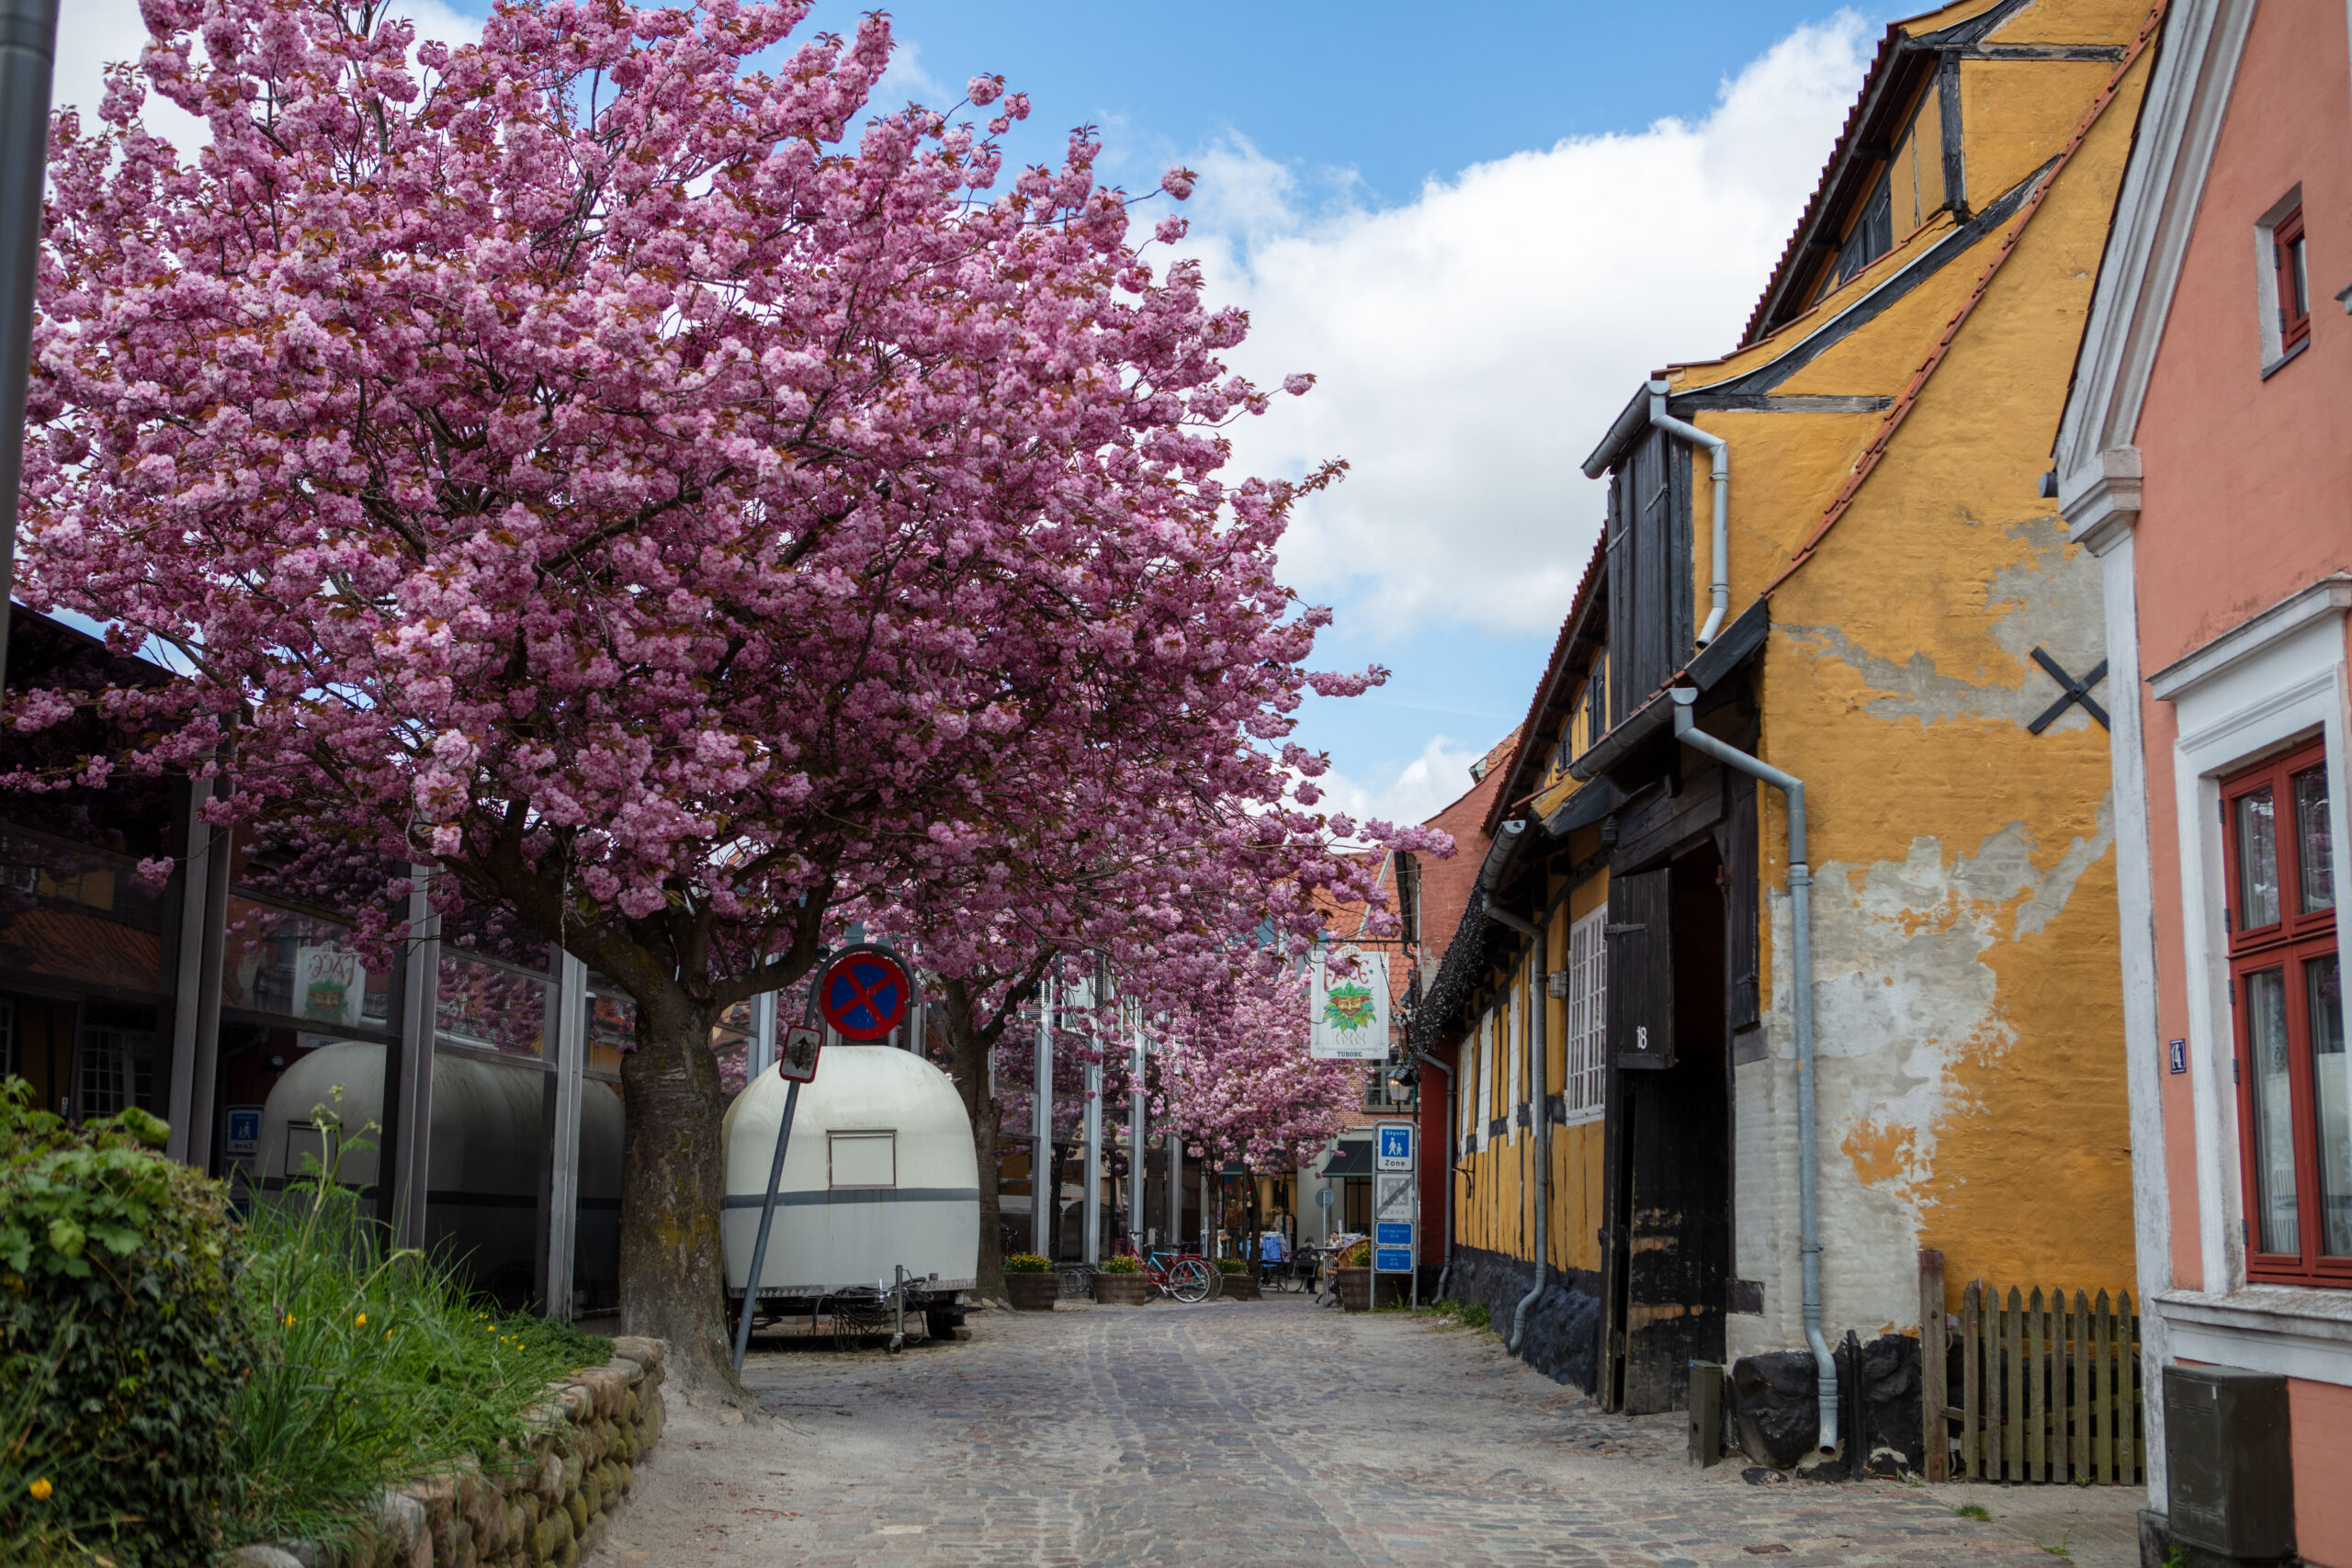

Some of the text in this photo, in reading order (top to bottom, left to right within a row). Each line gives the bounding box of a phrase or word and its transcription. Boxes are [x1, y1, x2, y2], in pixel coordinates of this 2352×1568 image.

[1340, 947, 1359, 956] THE
[1335, 1032, 1366, 1044] INN
[1636, 1025, 1647, 1049] 18
[2171, 1043, 2182, 1069] 14
